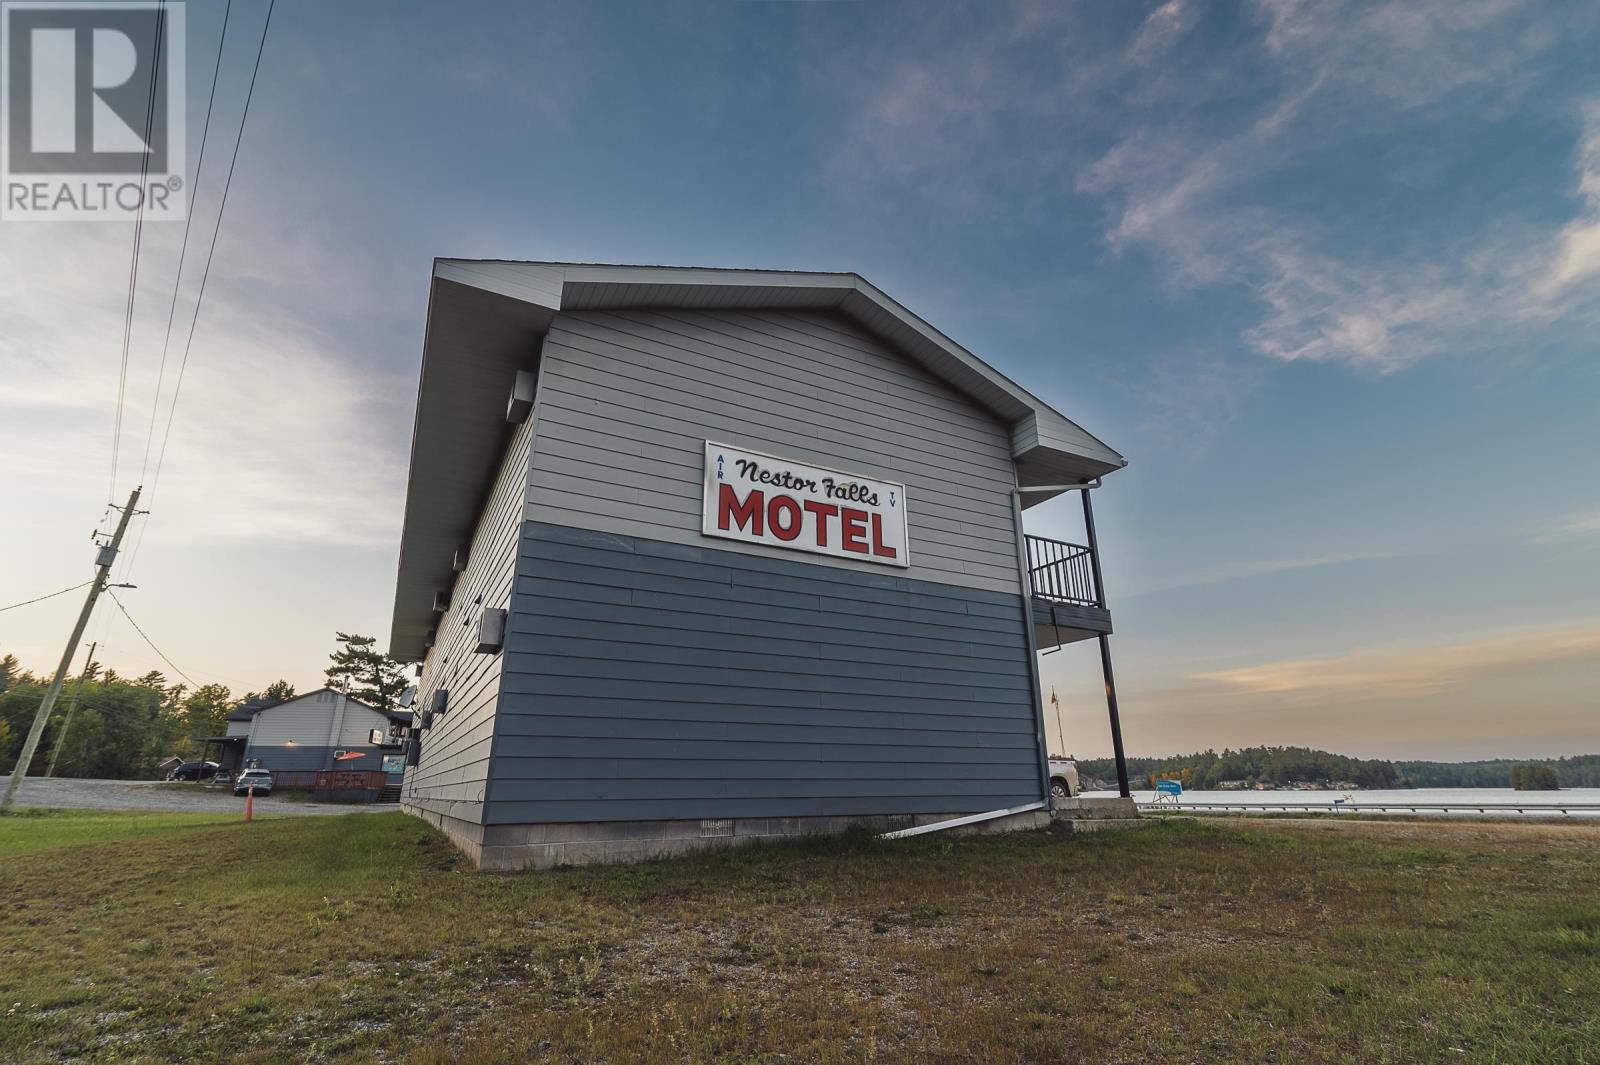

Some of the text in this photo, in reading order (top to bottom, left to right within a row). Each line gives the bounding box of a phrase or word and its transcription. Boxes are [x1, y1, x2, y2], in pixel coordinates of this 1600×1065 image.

[717, 454, 725, 480] AIR
[735, 459, 881, 507] Nestor Falls
[889, 491, 896, 508] TV
[717, 482, 897, 559] MOTEL
